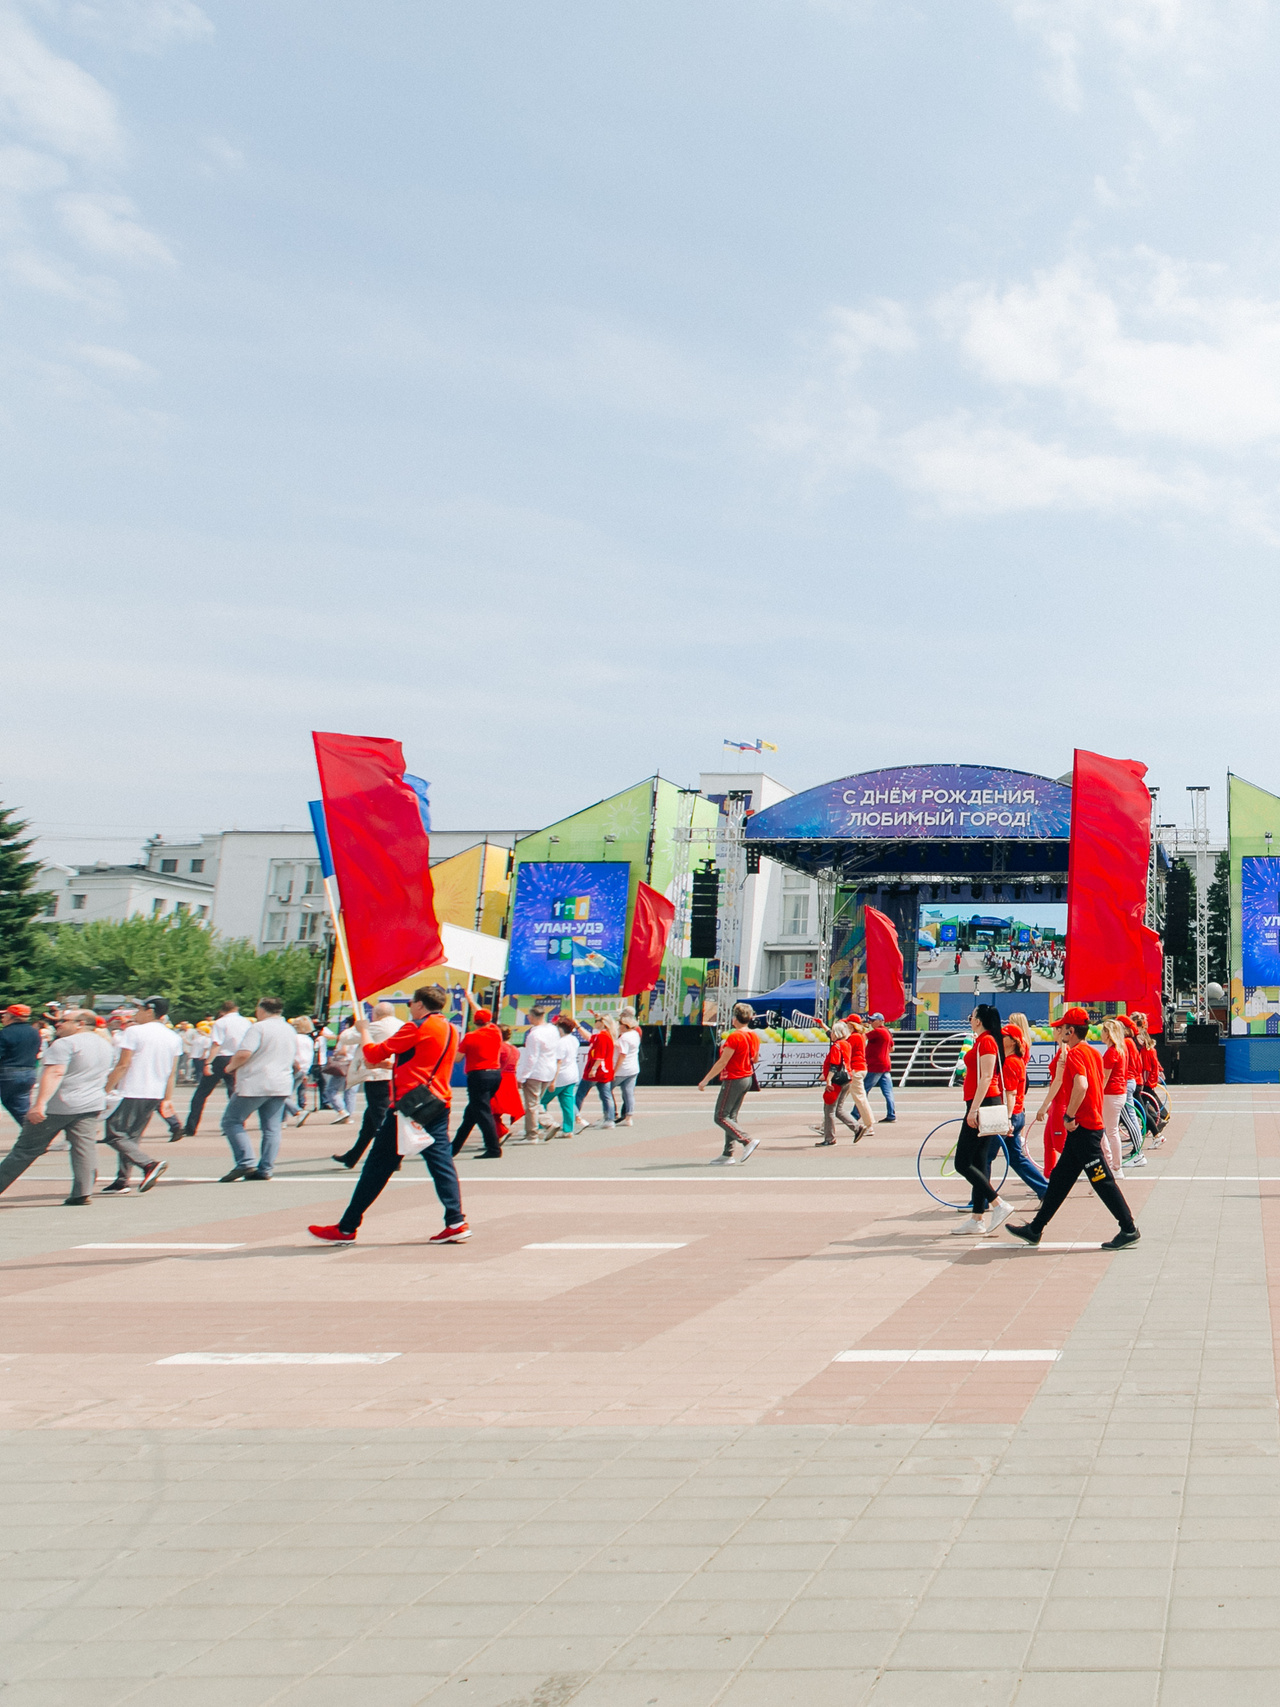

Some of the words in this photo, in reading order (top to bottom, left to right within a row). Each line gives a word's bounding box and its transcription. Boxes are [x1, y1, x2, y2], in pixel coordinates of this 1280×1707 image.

[842, 790, 857, 805] С
[860, 787, 917, 806] ДНЁМ
[922, 790, 1041, 806] РОЖДЕНИЯ,
[847, 808, 955, 826] ЛЮБИМЫЙ
[960, 811, 1032, 827] ГОРОД!
[534, 922, 604, 935] УЛАН-УДЭ
